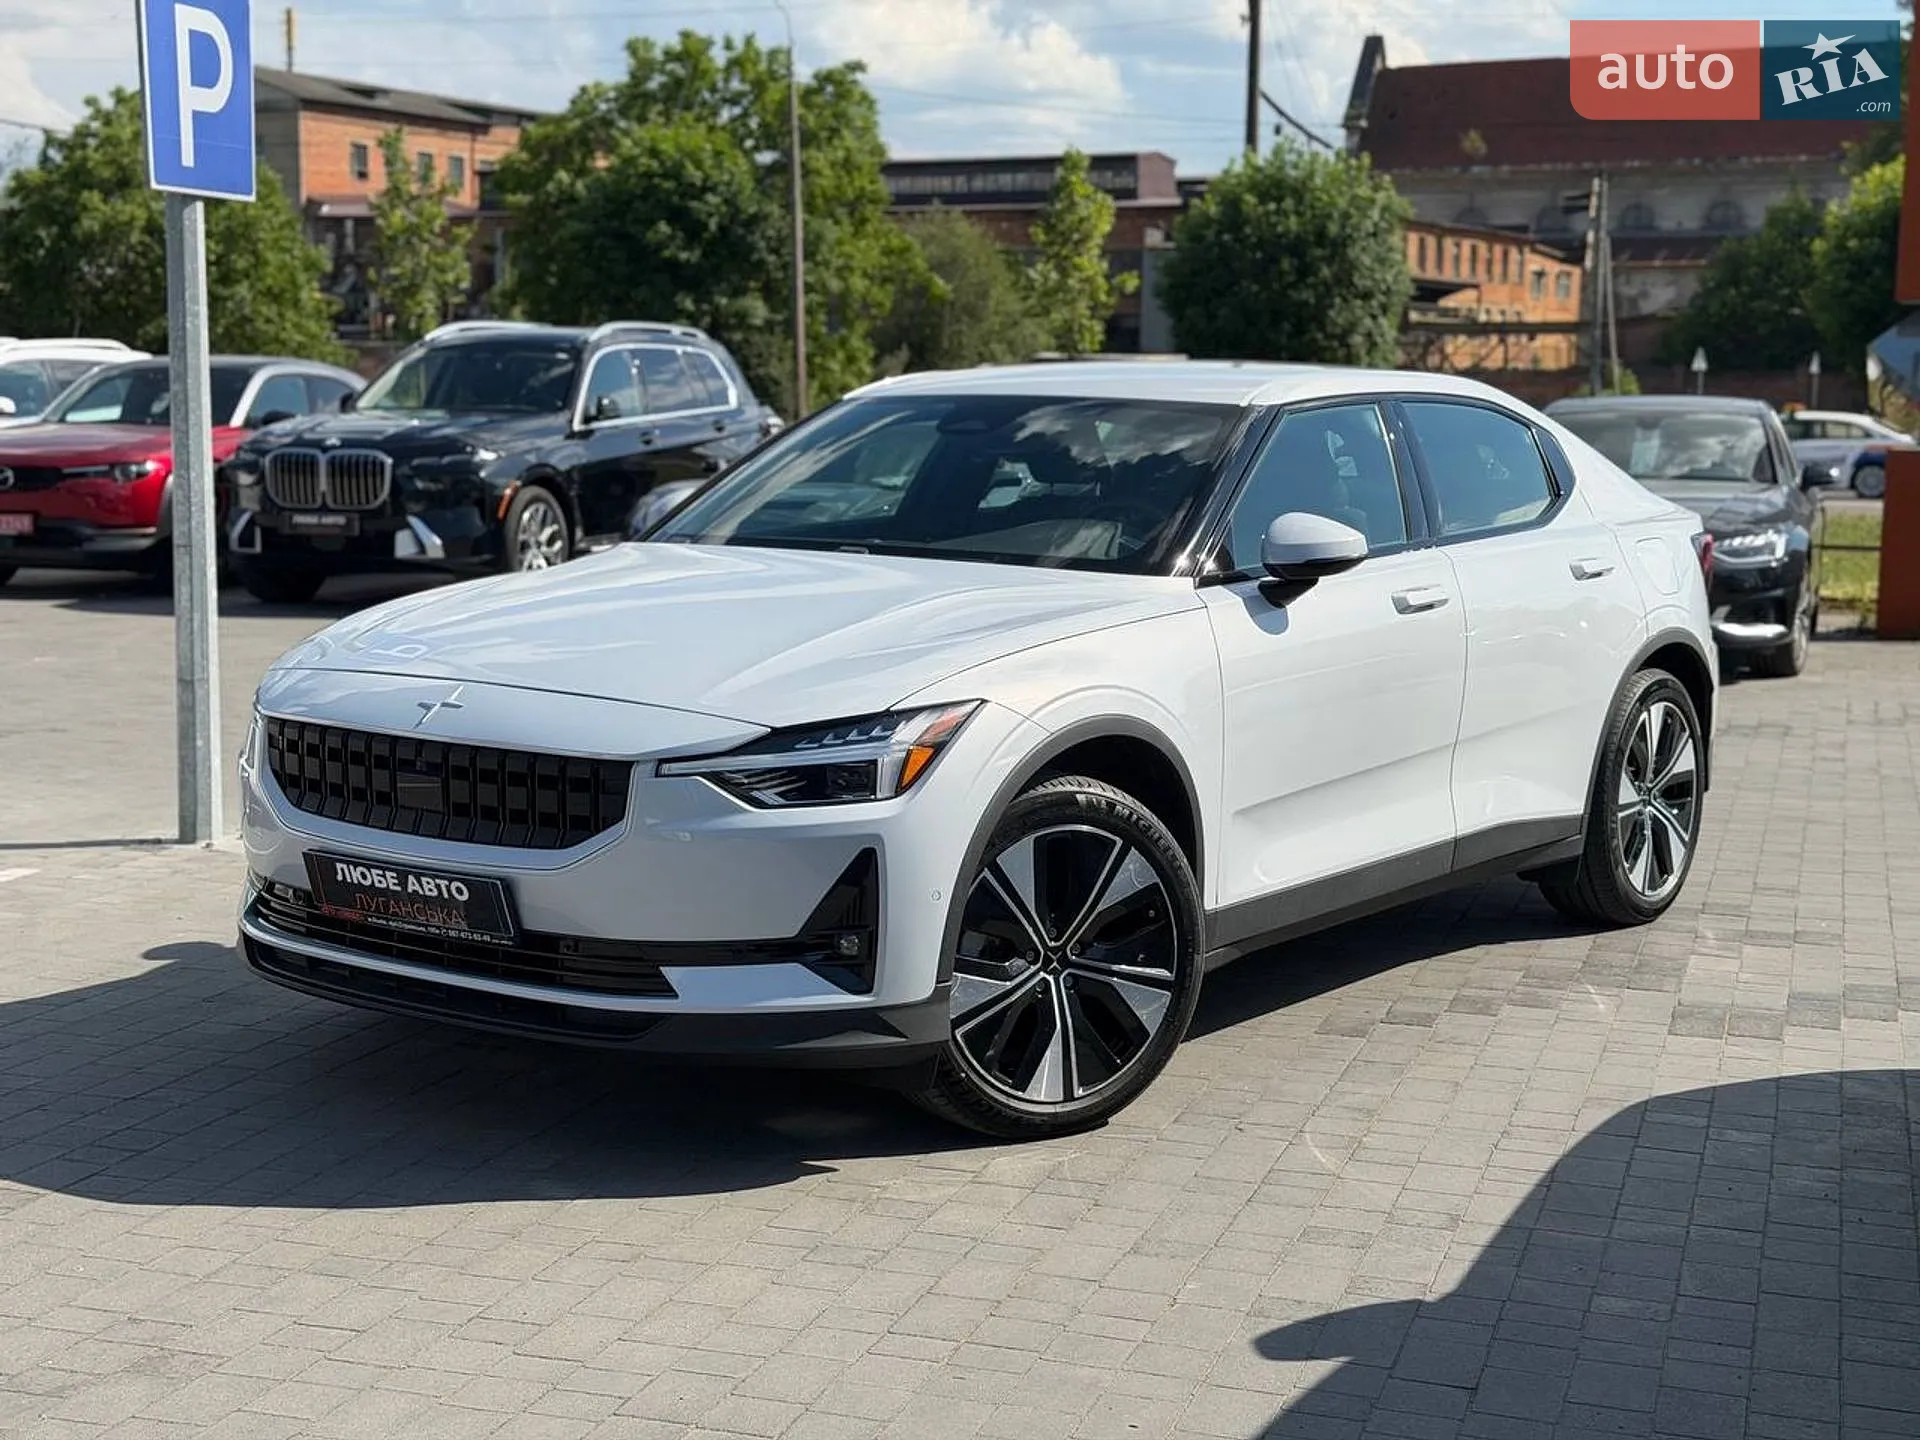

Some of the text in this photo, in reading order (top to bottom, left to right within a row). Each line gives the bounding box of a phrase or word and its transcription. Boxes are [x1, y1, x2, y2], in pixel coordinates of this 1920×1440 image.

[174, 3, 233, 167] P
[335, 862, 470, 902] ЛЮБЕ АВТО
[355, 893, 464, 926] ЛУГАНСЬКА
